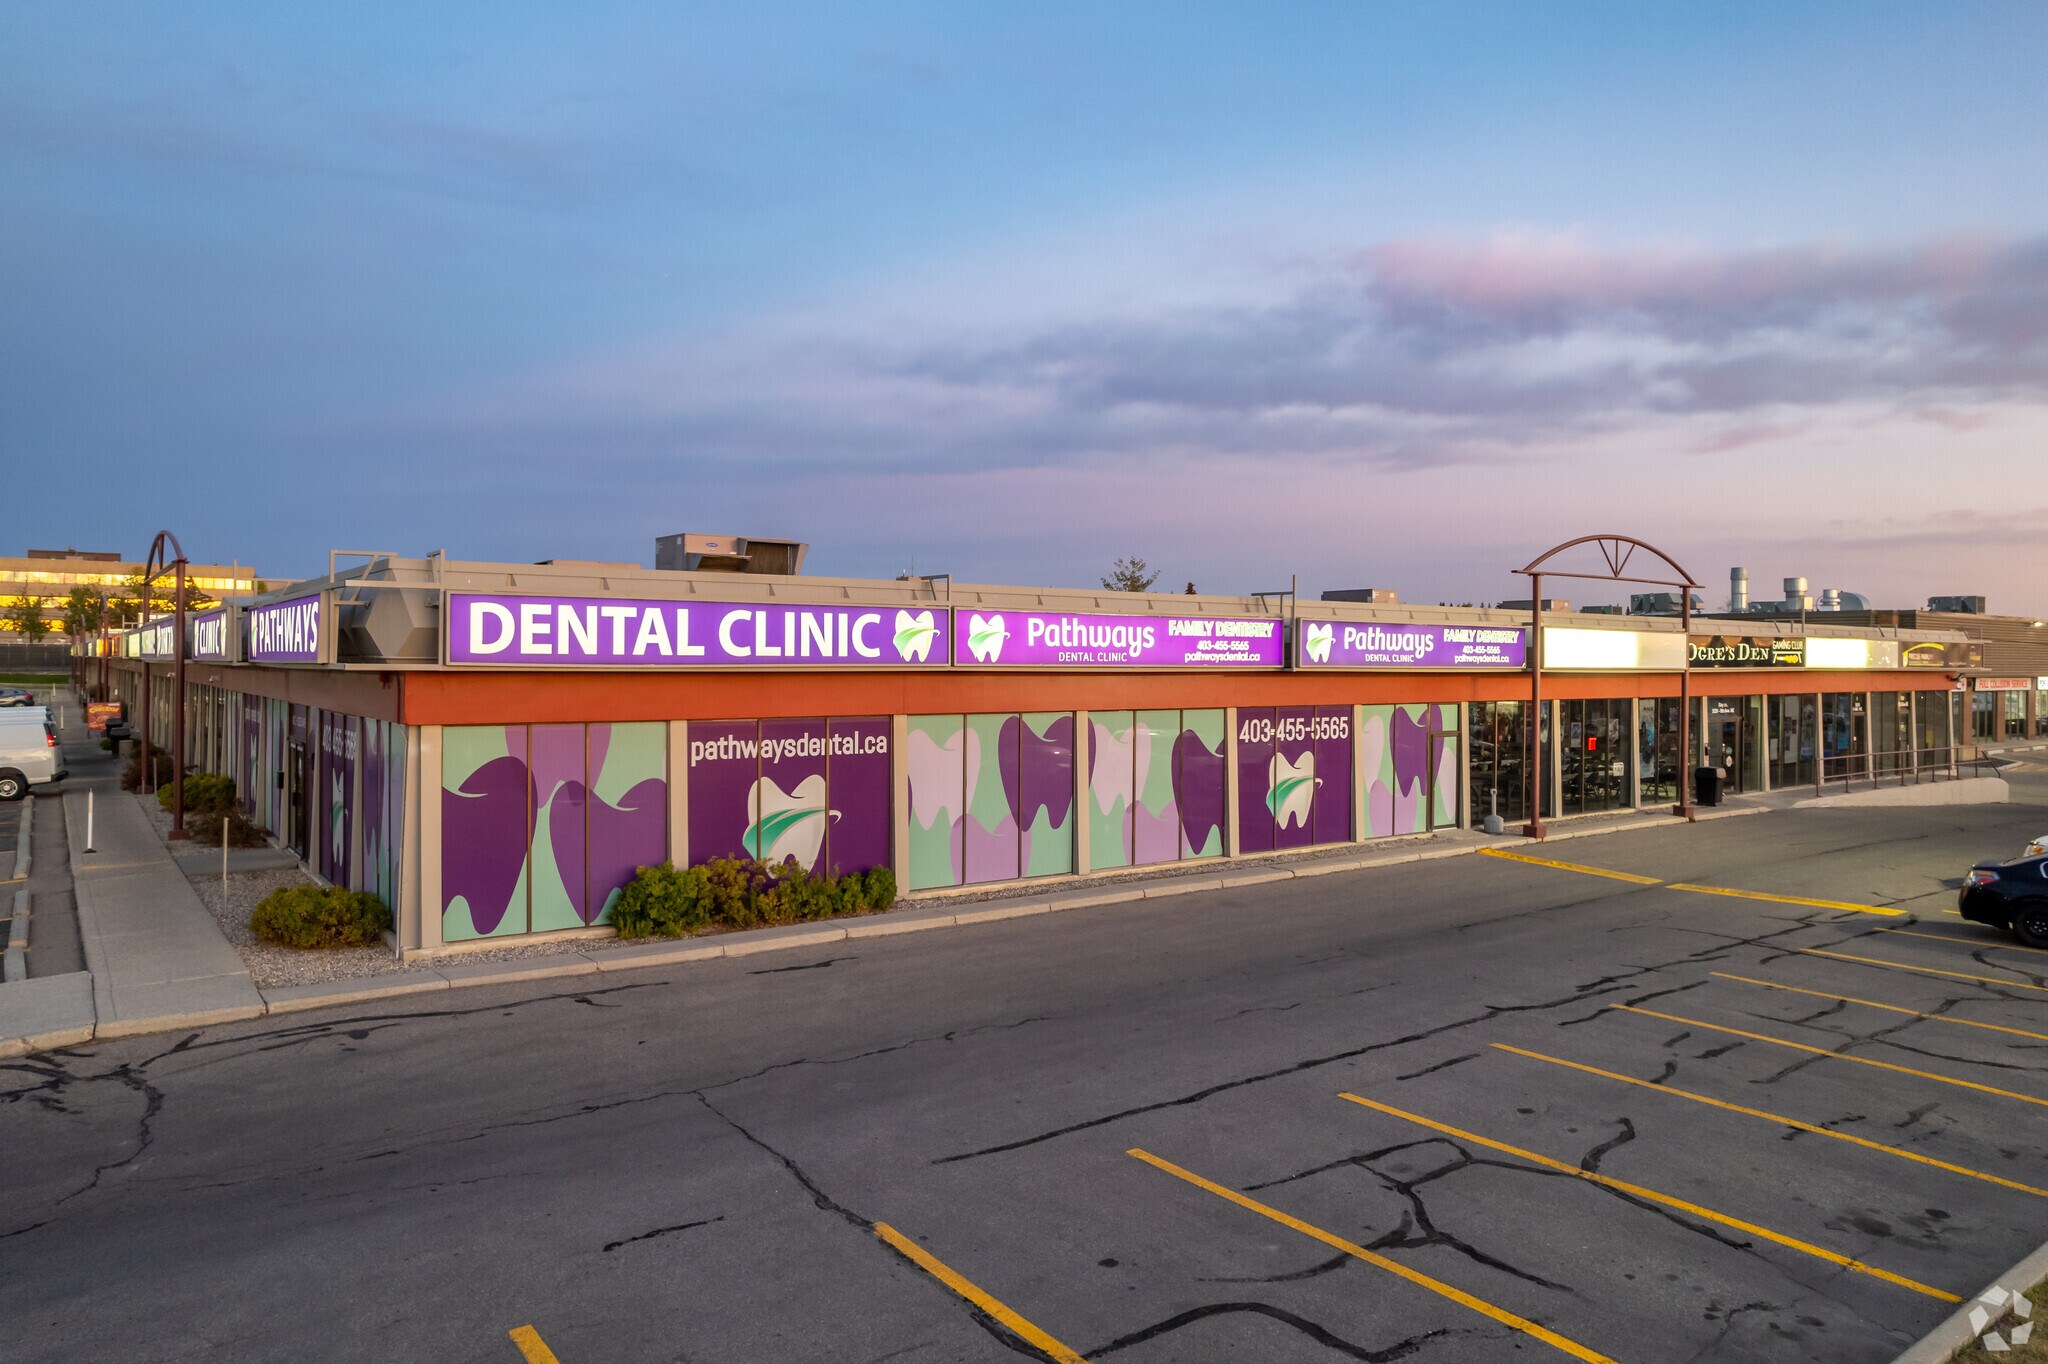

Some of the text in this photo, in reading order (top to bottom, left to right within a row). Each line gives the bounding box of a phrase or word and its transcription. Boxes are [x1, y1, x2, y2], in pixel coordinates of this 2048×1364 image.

[259, 601, 319, 653] PATHWAYS
[470, 601, 880, 658] DENTAL CLINIC
[1168, 620, 1275, 637] FAMILY DENTISTRY
[1028, 617, 1155, 658] Pathways
[1344, 626, 1434, 659] Pathways
[1443, 629, 1520, 644] FAMILY DENTISTRY
[1196, 640, 1250, 651] 403-455-5565
[1737, 643, 1770, 661] DEN
[1058, 651, 1128, 663] DENTAL CLINIC
[1184, 651, 1261, 663] pathwaysdental.ca
[1365, 653, 1414, 663] DENTAL CLINIC
[2011, 679, 2028, 688] SERVICE
[1239, 716, 1349, 743] 403-455-5565
[691, 730, 887, 767] pathwaysdental.ca
